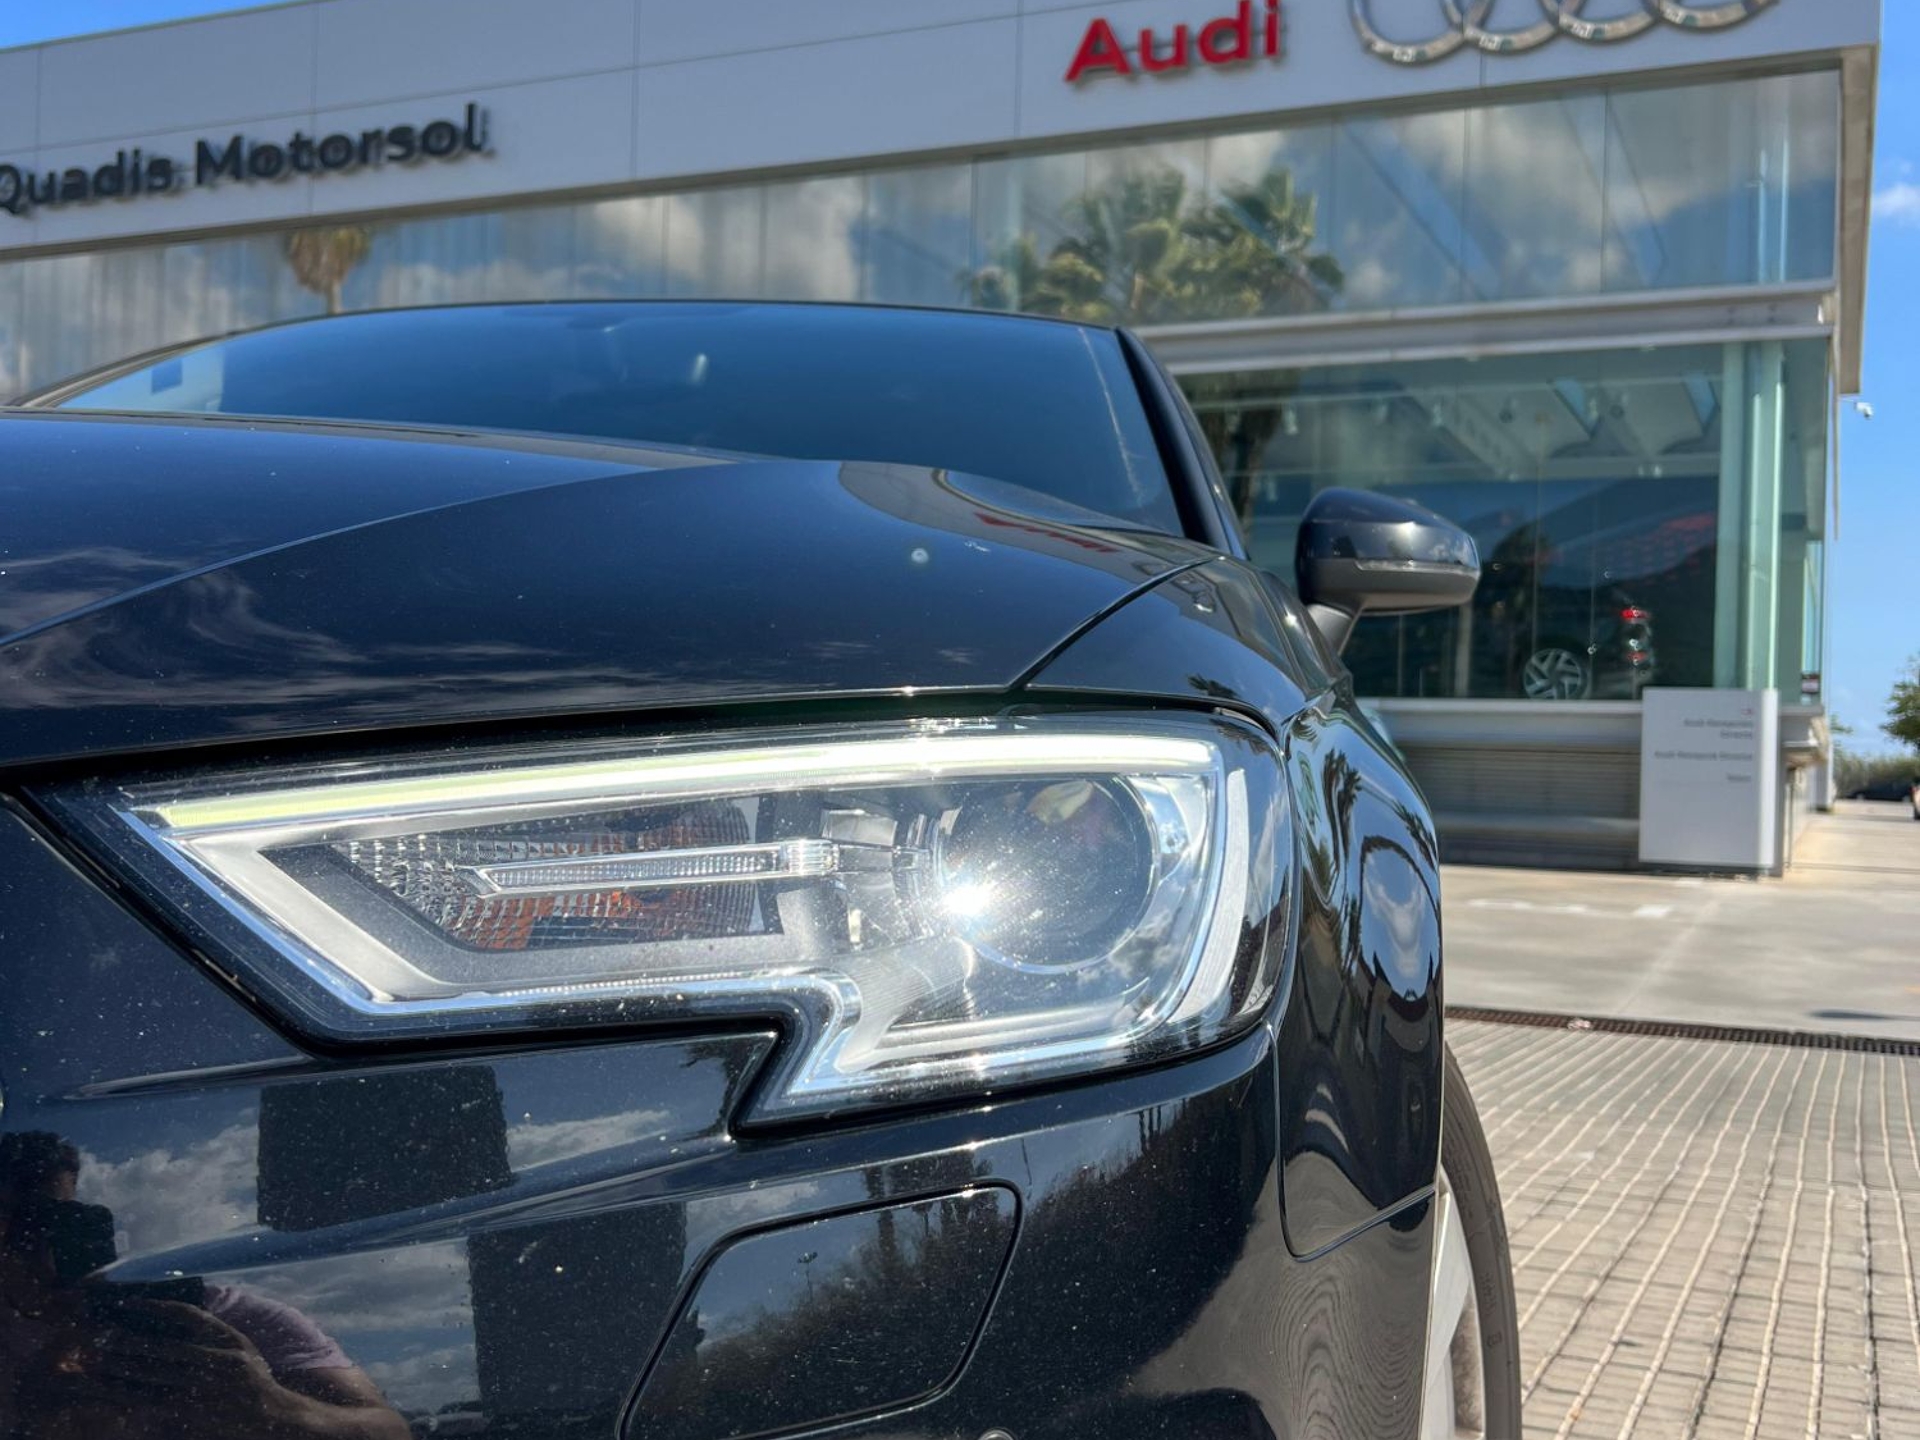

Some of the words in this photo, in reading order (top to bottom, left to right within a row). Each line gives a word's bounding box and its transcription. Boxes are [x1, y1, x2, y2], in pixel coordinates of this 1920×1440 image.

[1064, 0, 1281, 82] Audi
[0, 149, 172, 215] Quadis
[195, 103, 487, 185] Motorsol
